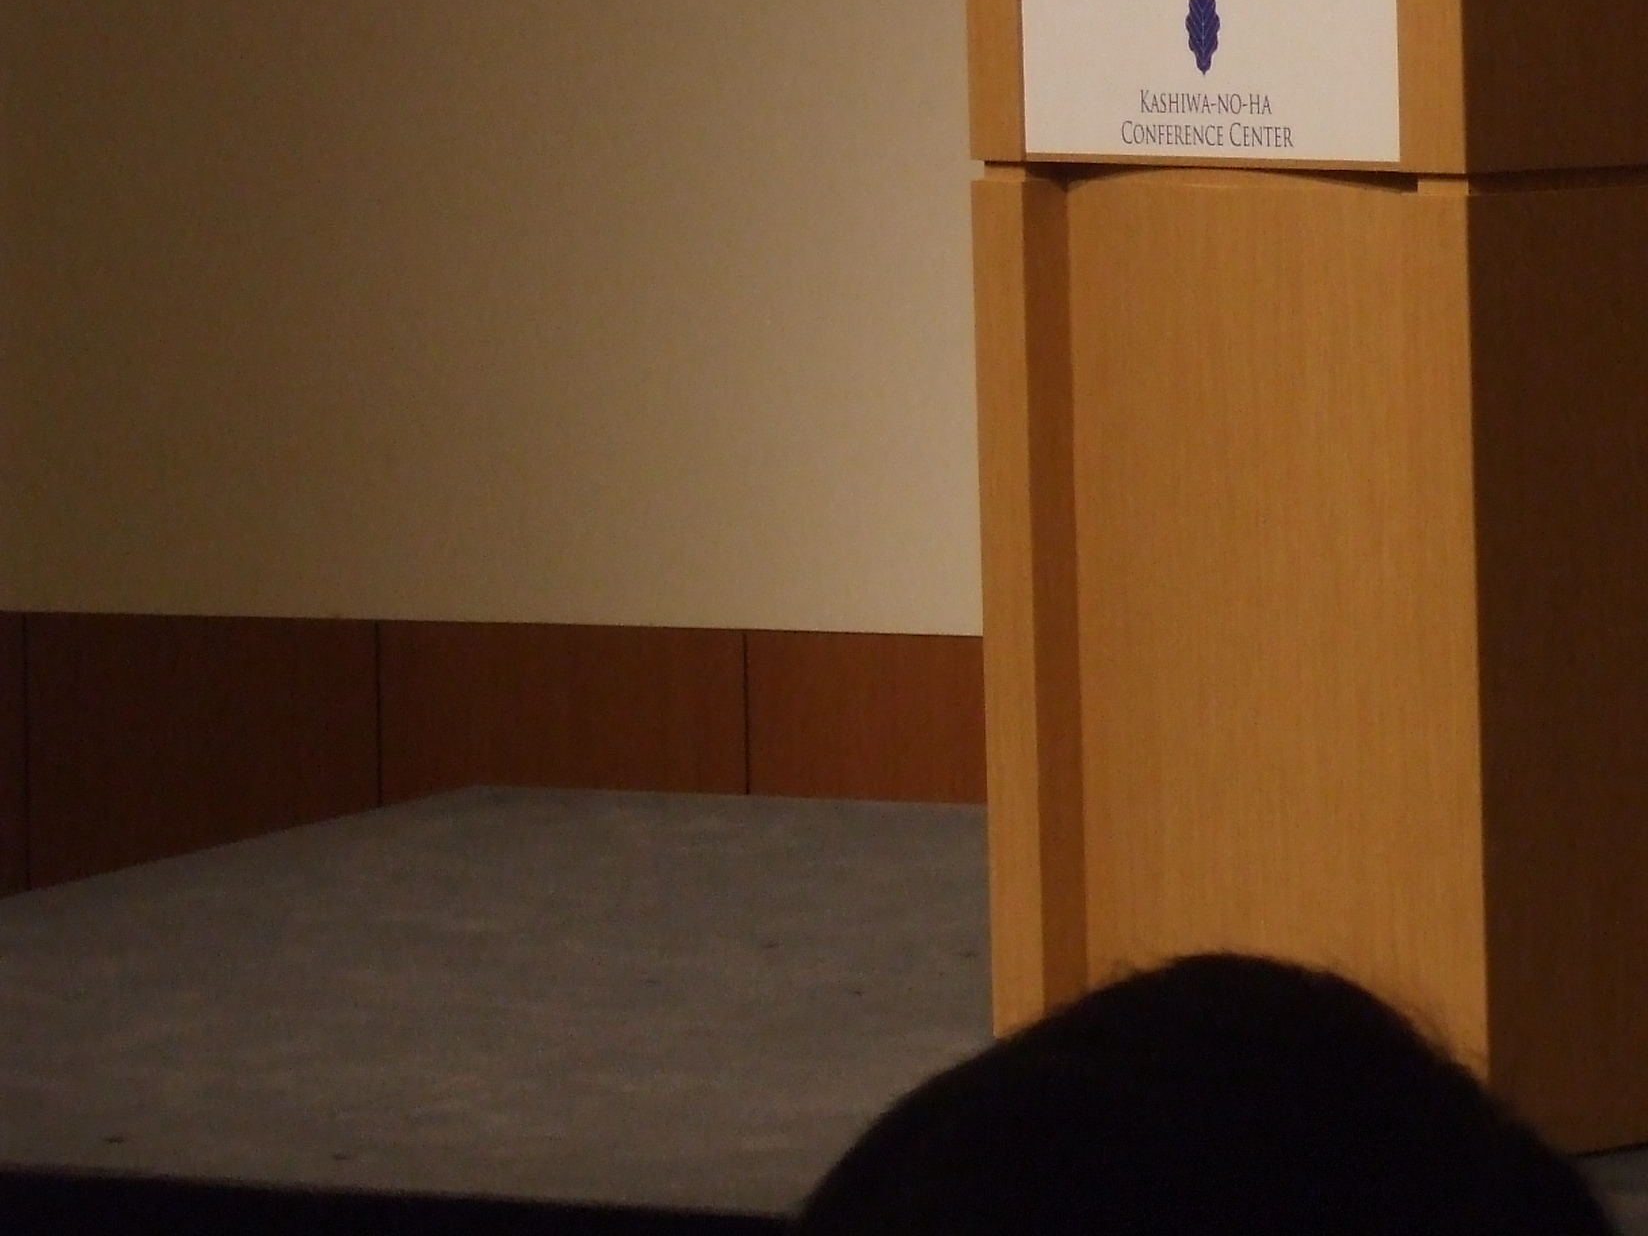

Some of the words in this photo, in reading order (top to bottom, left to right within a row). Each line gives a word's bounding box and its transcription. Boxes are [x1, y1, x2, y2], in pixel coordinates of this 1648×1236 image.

[1139, 89, 1272, 115] KASHIWA-NO-HA
[1121, 120, 1224, 146] CONFERENCE
[1229, 122, 1294, 148] CENTER
